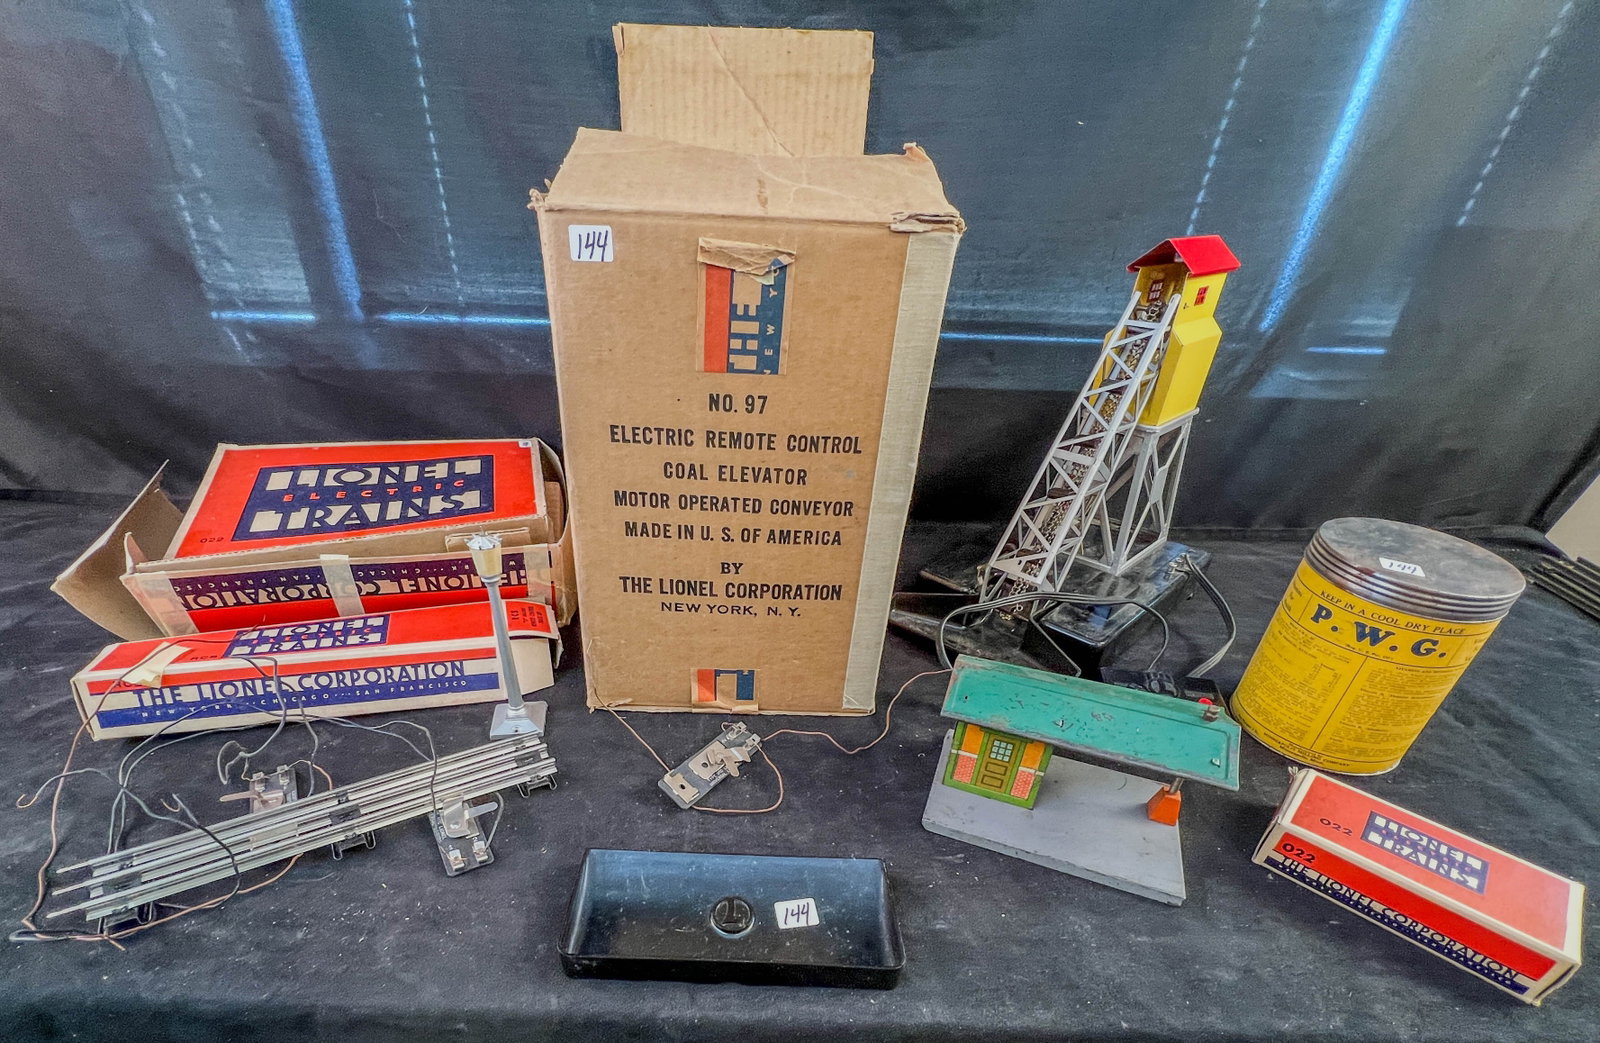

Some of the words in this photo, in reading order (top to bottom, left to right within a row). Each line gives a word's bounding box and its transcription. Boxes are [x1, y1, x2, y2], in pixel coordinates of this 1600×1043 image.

[577, 230, 608, 262] 144
[708, 393, 738, 414] NO.
[745, 395, 768, 415] 97
[609, 424, 694, 447] ELECTRIC
[705, 430, 777, 451] REMOTE
[786, 434, 862, 455] CONTROL
[275, 459, 474, 490] LIONEL
[663, 461, 708, 481] COAL
[718, 464, 808, 485] ELEVATOR
[283, 480, 465, 502] ELECTRIC
[613, 490, 670, 509] MOTOR
[678, 494, 762, 514] OPERATED
[770, 499, 854, 517] CONVEYOR
[265, 491, 472, 532] TRAINS
[199, 536, 225, 544] 022
[624, 521, 672, 539] MADE
[678, 524, 694, 540] IN
[700, 525, 714, 541] U.
[721, 526, 735, 542] S.
[740, 528, 761, 543] OF
[766, 529, 842, 546] AMERICA
[357, 568, 421, 578] CHICAG
[720, 562, 744, 575] BY
[619, 576, 652, 594] THE
[659, 578, 718, 597] LIONEL
[725, 583, 842, 602] CORPORATION
[660, 602, 700, 613] NEW
[706, 604, 758, 617] YORK,
[767, 606, 783, 617] N.
[788, 607, 801, 617] Y.
[1320, 590, 1342, 604] KEEP
[1344, 602, 1355, 611] IN
[1371, 612, 1400, 626] COOL
[1404, 621, 1430, 631] DRY
[1432, 627, 1466, 635] PLACE
[248, 617, 379, 641] LIONEL
[252, 628, 372, 644] ELECTRIC
[1310, 603, 1339, 633] P.
[1354, 621, 1398, 652] W.
[1411, 638, 1447, 658] G.
[239, 633, 376, 656] TRAINS
[133, 686, 182, 708] THE
[199, 675, 291, 701] LIONEL
[298, 660, 465, 692] CORPORATION
[142, 708, 175, 717] NEW
[260, 693, 329, 705] CHICAGO
[356, 688, 380, 696] SAN
[391, 680, 467, 693] FRANCISCO
[1320, 818, 1353, 837] 022
[1282, 843, 1316, 863] 022
[1380, 817, 1478, 869] LIONEL
[1373, 832, 1474, 887] TRAINS
[783, 900, 812, 926] 144
[1282, 856, 1308, 874] THE
[1318, 873, 1374, 906] LIONEL
[1381, 907, 1520, 980] CORPORATION
